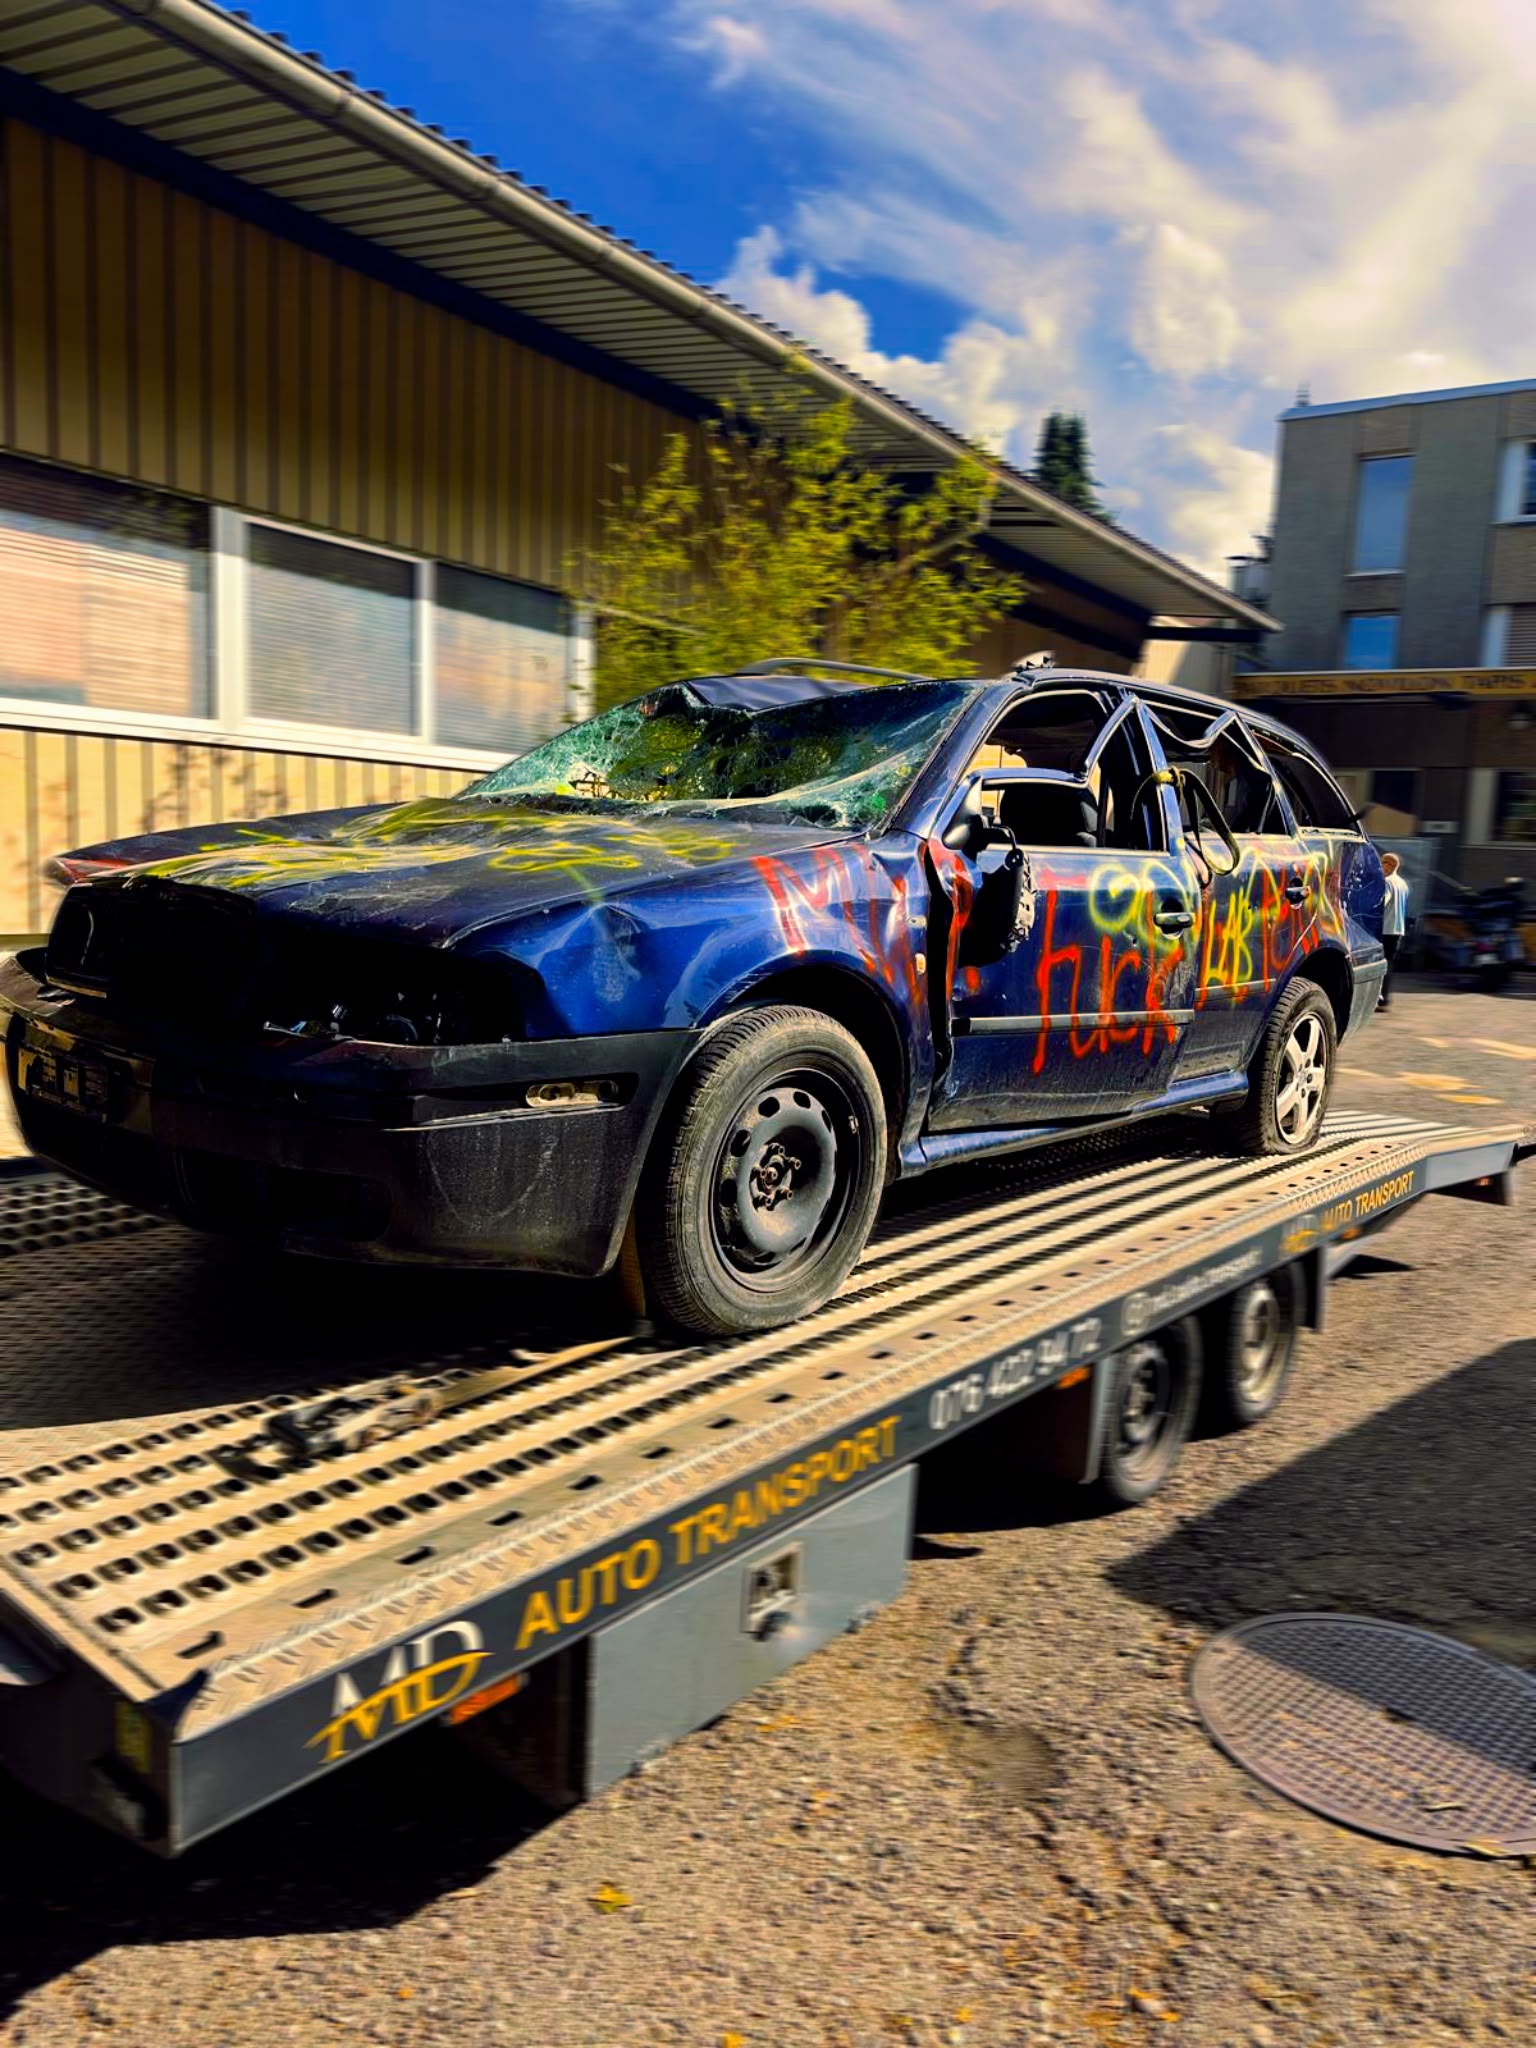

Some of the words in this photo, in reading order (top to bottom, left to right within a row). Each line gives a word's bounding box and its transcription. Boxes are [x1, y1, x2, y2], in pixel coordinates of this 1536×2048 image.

[1321, 1200, 1353, 1231] AUTO
[1355, 1171, 1414, 1217] TRANSPORT
[929, 1373, 984, 1430] 076
[1070, 1317, 1102, 1358] 72
[514, 1539, 661, 1650] AUTO
[668, 1415, 901, 1567] TRANSPORT
